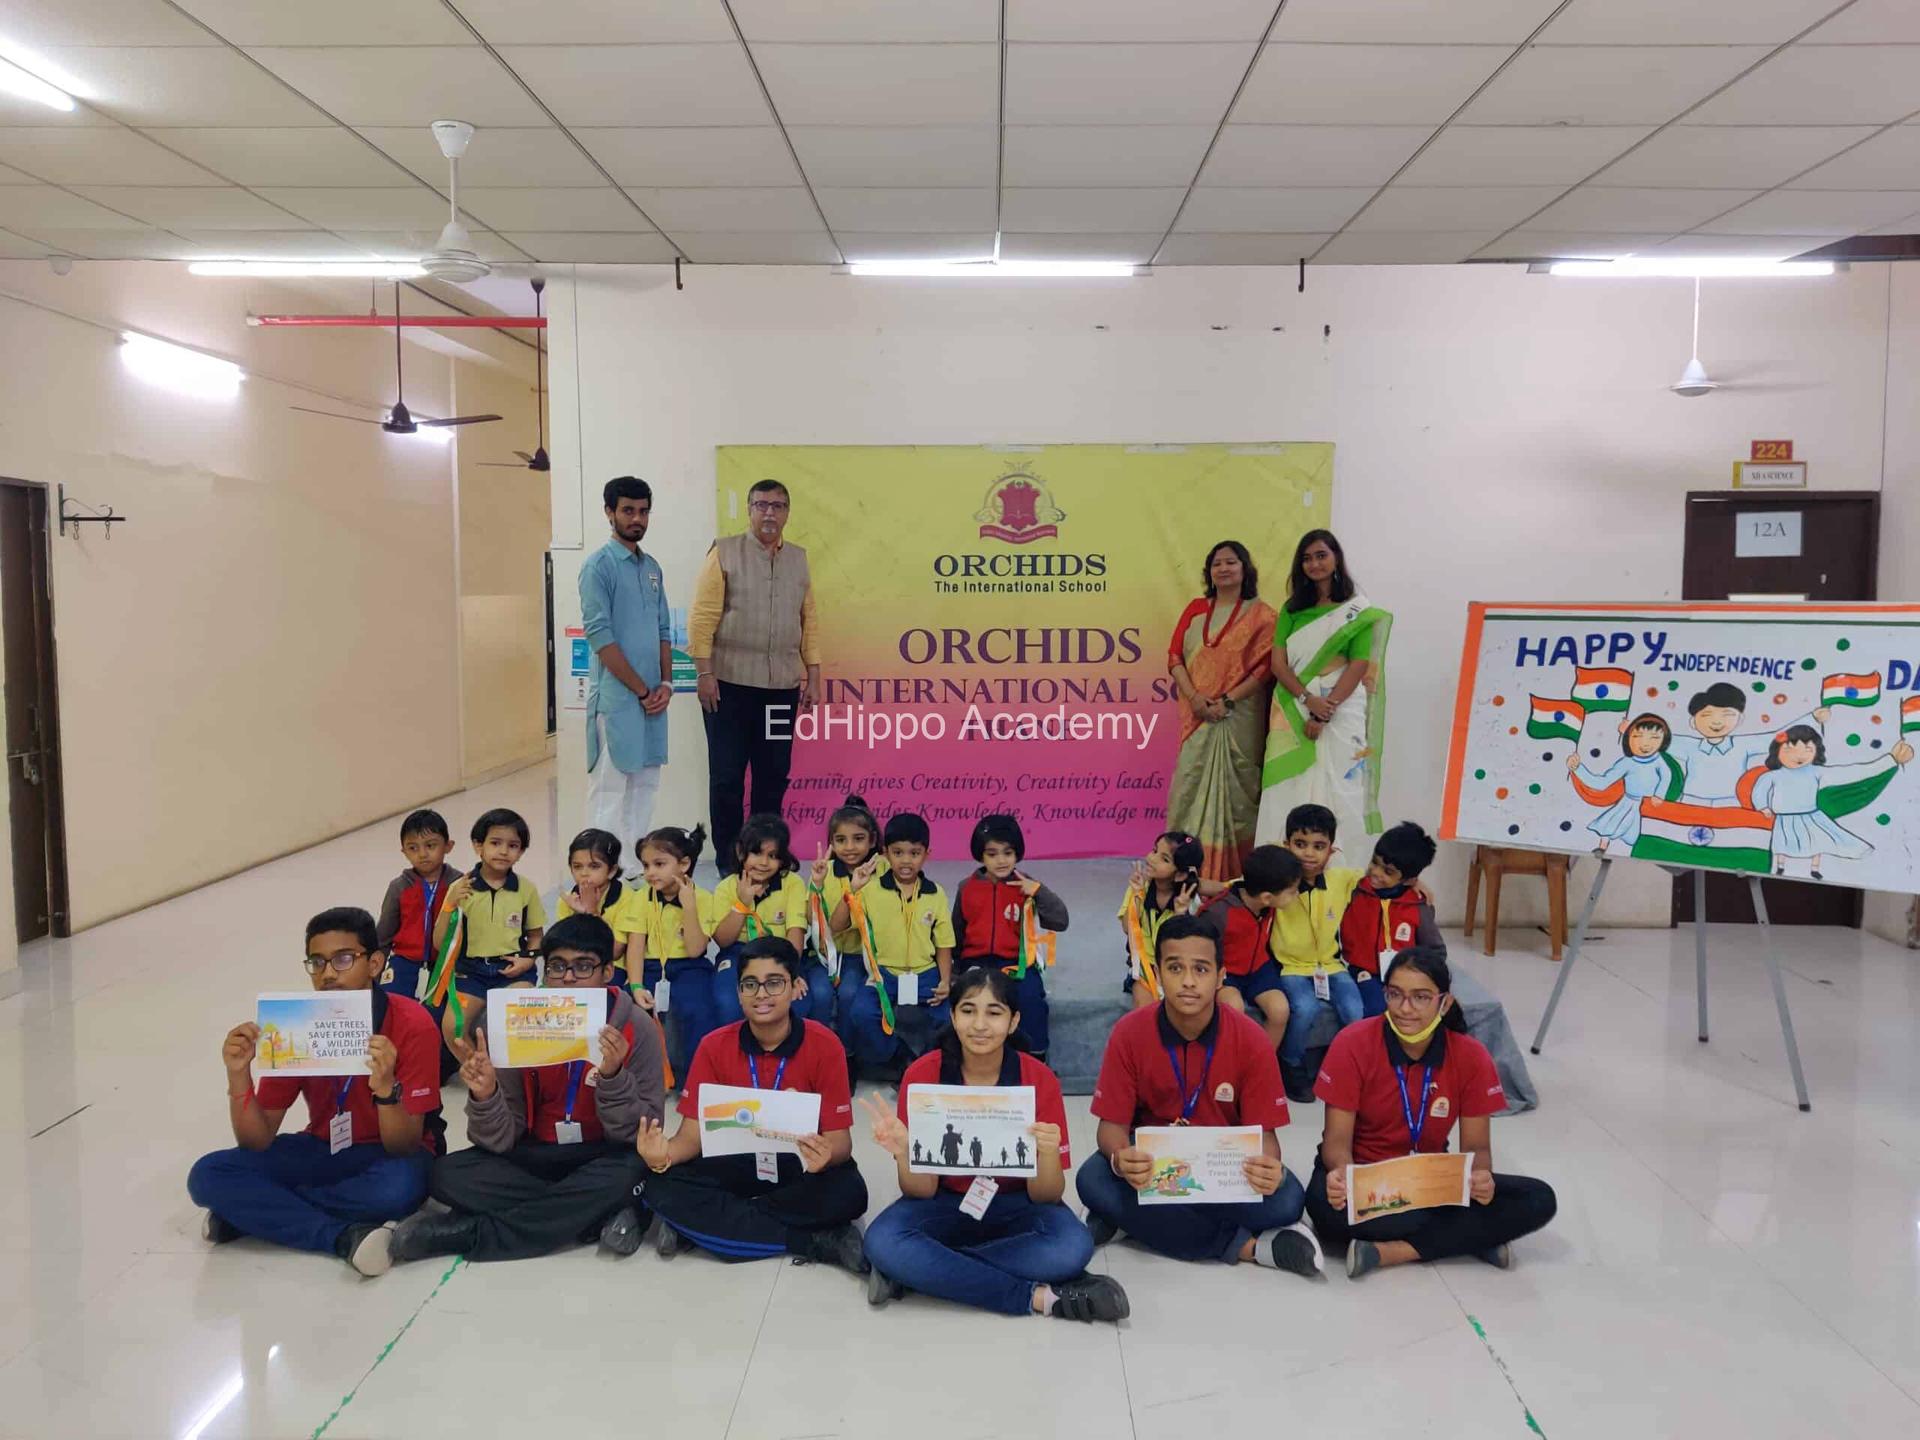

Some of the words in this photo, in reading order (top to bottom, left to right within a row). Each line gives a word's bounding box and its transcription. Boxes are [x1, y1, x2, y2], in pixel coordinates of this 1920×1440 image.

[1755, 443, 1788, 458] 224
[1753, 522, 1786, 537] 12A
[933, 553, 1107, 578] ORCHIDS
[934, 580, 959, 593] The
[964, 580, 1054, 593] International
[1059, 580, 1107, 593] School
[898, 627, 1142, 664] ORCHIDS
[1515, 631, 1667, 667] HAPPY
[1660, 652, 1796, 681] INDEPENDENCE
[824, 678, 1138, 704] INTERNATIONAL
[857, 772, 904, 795] gives
[911, 772, 1008, 796] Creativity,
[1016, 772, 1111, 795] Creativity
[1116, 770, 1165, 790] leads
[1032, 801, 1137, 825] Knowledge
[314, 1021, 336, 1029] SAVE
[308, 1031, 331, 1039] SAVE
[311, 1040, 319, 1049] &
[316, 1049, 339, 1057] SAVE
